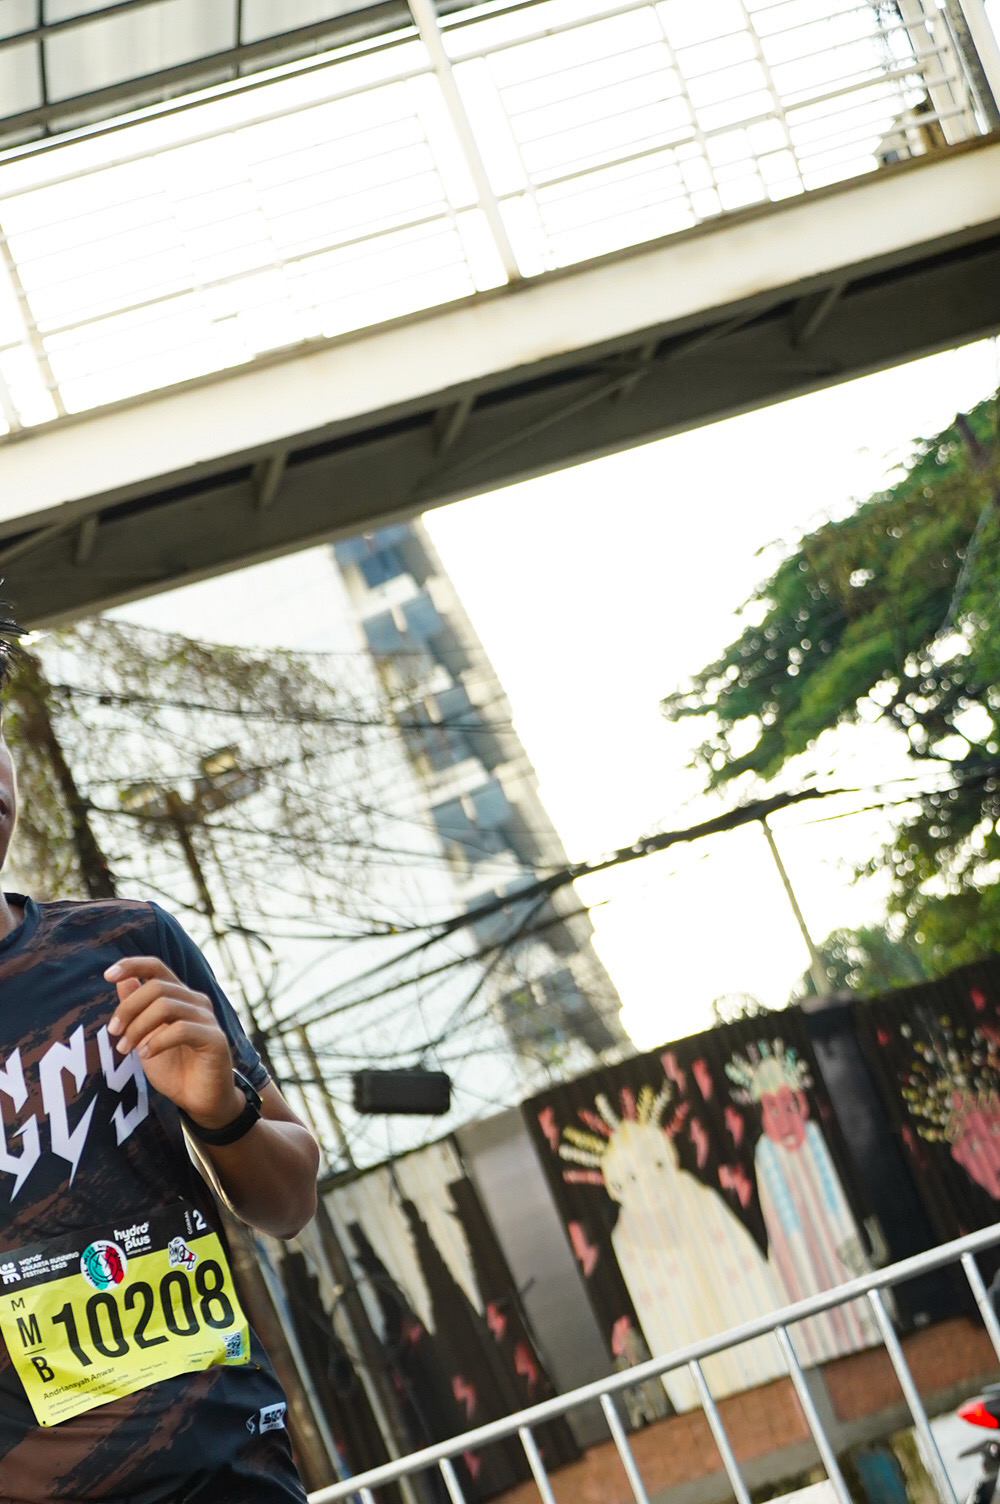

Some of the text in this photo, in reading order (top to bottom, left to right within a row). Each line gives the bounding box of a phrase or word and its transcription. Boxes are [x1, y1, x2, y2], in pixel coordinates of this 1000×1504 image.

[113, 1221, 149, 1241] hydro
[192, 1209, 207, 1231] 2
[124, 1234, 151, 1252] plus
[20, 1251, 80, 1273] JAKARTA RUNNING
[22, 1266, 51, 1279] FESTIVAL
[10, 1297, 26, 1312] M
[51, 1258, 235, 1367] 10208
[15, 1313, 42, 1348] M
[31, 1356, 55, 1383] B
[43, 1377, 90, 1400] Andriansyah
[90, 1366, 115, 1381] Anwar
